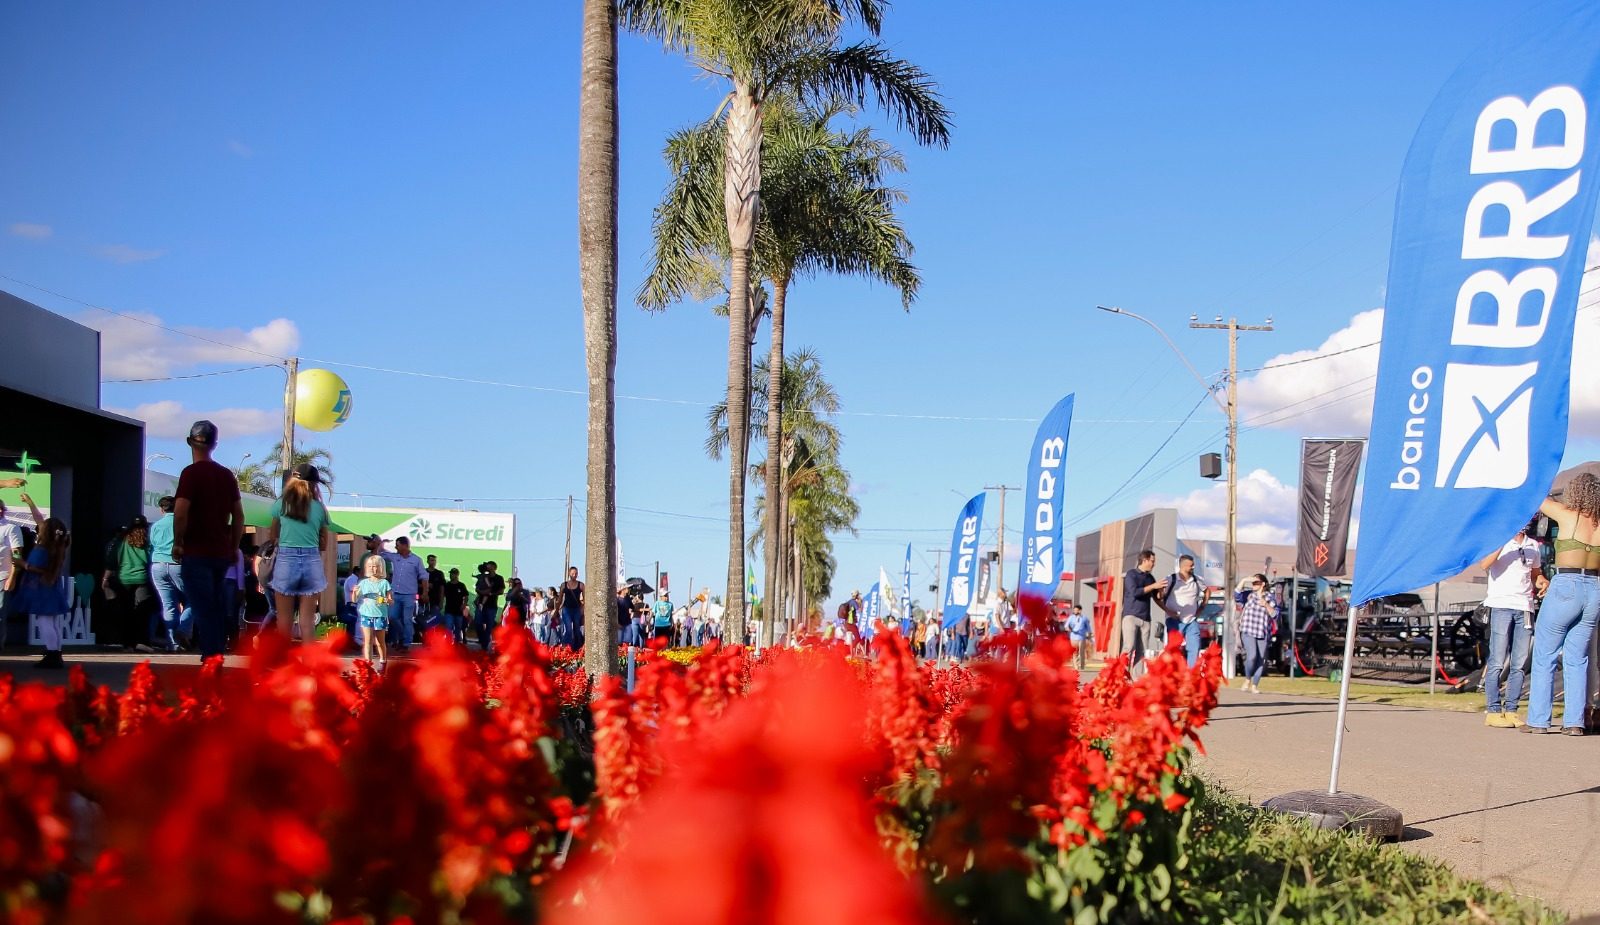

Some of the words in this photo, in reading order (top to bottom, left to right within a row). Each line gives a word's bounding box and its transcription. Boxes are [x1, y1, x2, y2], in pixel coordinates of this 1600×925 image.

[1450, 85, 1587, 349] BRB
[1390, 365, 1433, 490] banco
[435, 523, 505, 542] Sicredi
